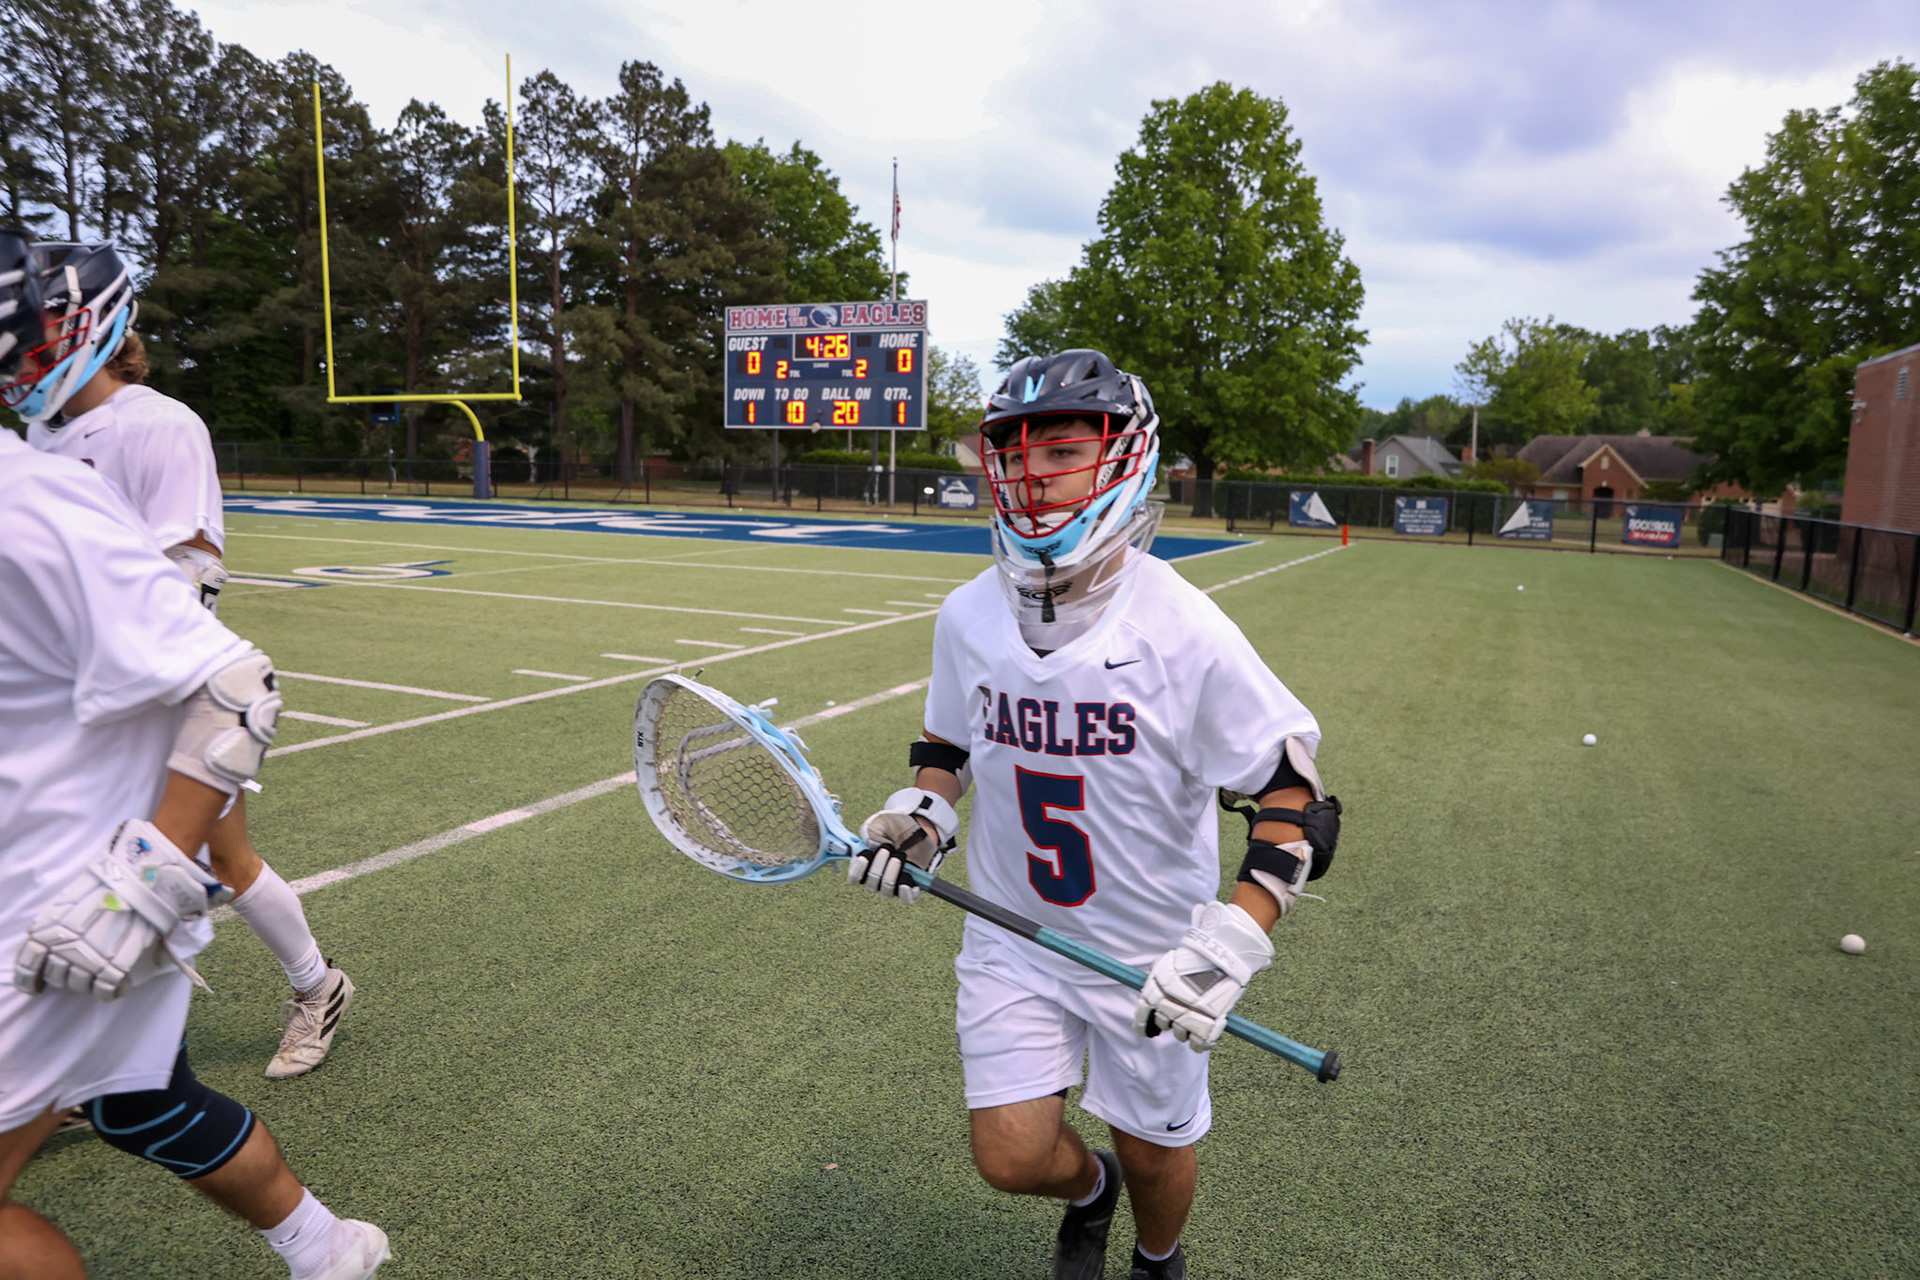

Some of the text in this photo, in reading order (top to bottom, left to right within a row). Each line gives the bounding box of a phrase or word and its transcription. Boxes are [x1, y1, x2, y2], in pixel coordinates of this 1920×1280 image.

[730, 307, 787, 329] HOME
[841, 303, 925, 325] EAGLES
[728, 337, 768, 351] GUEST
[805, 334, 850, 358] 4:26
[879, 333, 919, 348] HOME
[747, 351, 761, 375] 0
[776, 360, 789, 380] 2
[855, 358, 868, 379] 2
[897, 348, 913, 373] 0
[733, 388, 765, 400] DOWN
[774, 388, 809, 400] TO GO
[821, 387, 872, 400] BALL ON
[884, 387, 912, 400] QTR.
[748, 401, 756, 424] 1
[786, 400, 806, 424] 10
[832, 400, 860, 425] 20
[898, 401, 906, 425] 1
[1015, 764, 1097, 908] 5
